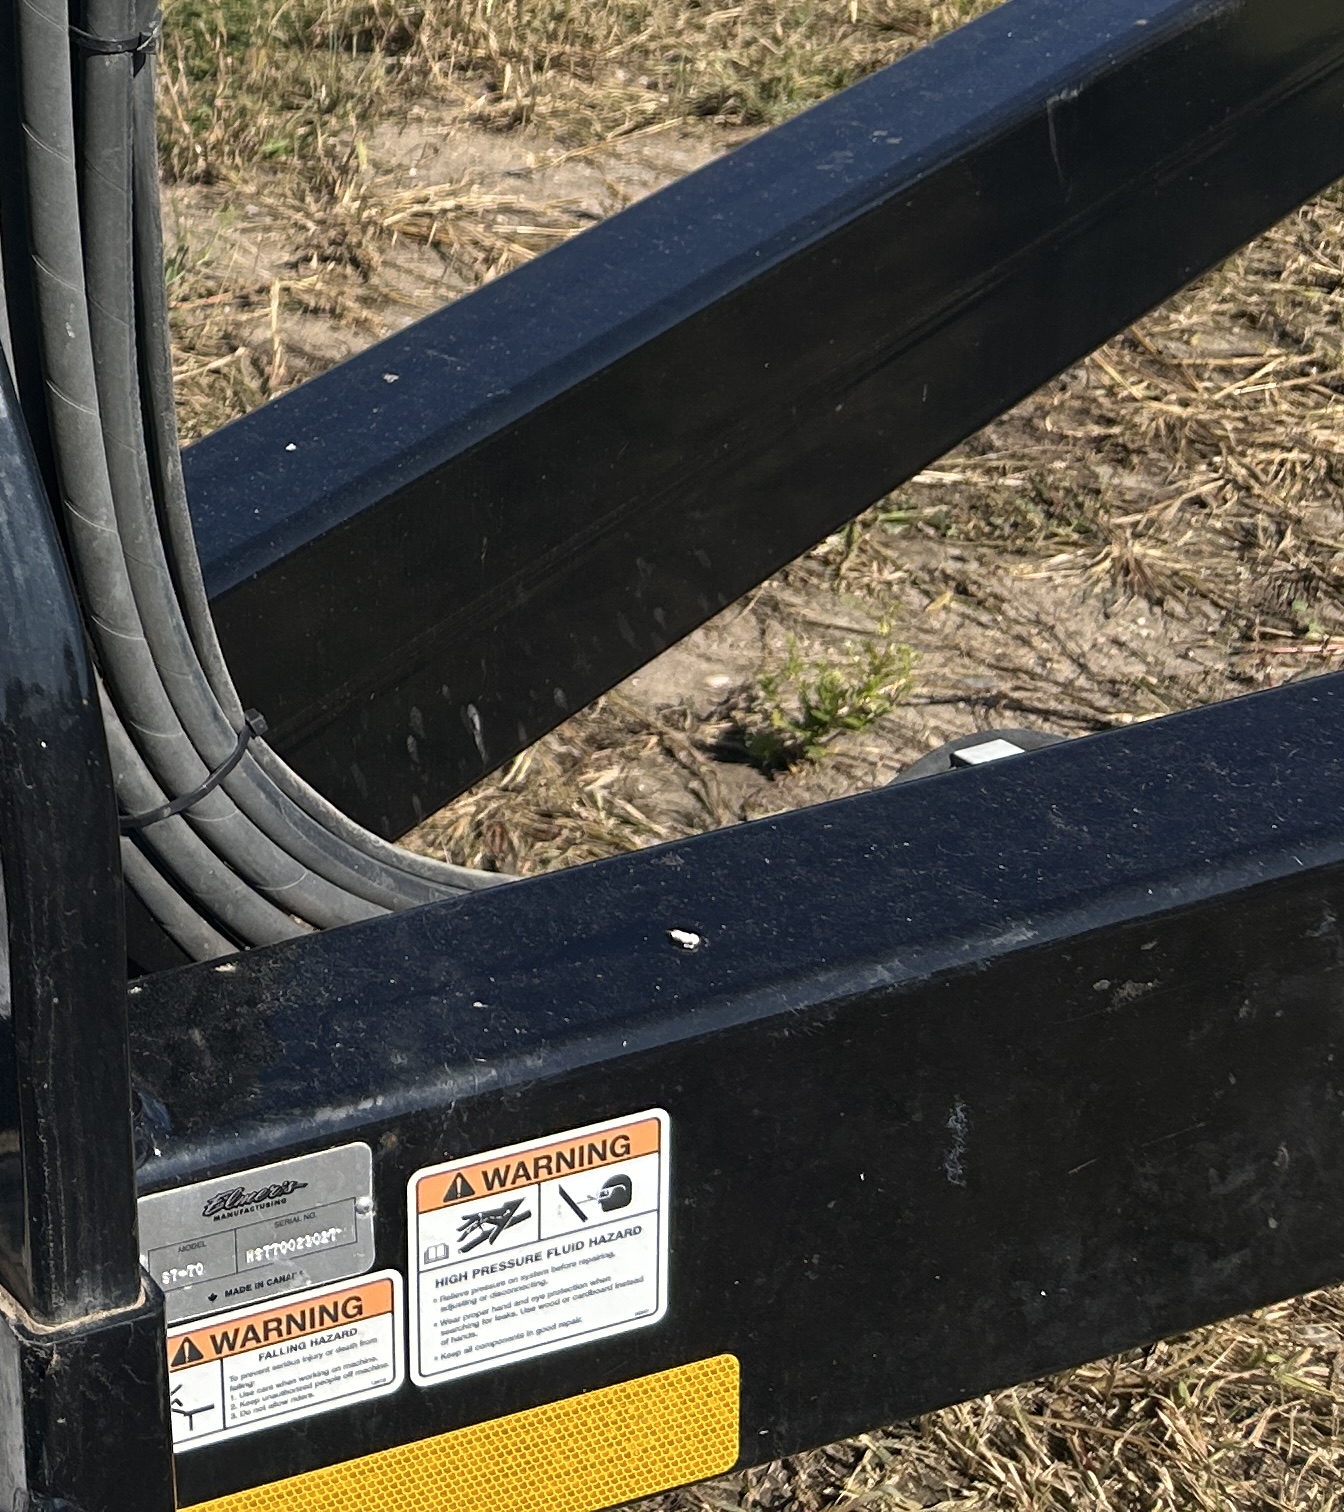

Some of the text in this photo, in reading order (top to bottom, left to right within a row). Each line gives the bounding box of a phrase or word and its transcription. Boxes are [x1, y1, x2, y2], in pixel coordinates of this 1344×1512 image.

[480, 1132, 630, 1193] WARNING
[212, 1197, 287, 1222] MANUFACTURING
[274, 1215, 301, 1228] SERIAL
[435, 1224, 642, 1288] HIGH PRESSURE FLUID HAZARD
[224, 1283, 251, 1298] MADE
[254, 1280, 263, 1290] IN
[491, 1301, 511, 1312] hand
[514, 1296, 528, 1306] and
[209, 1293, 363, 1356] WARNING
[258, 1326, 357, 1361] FALLING HAZARD
